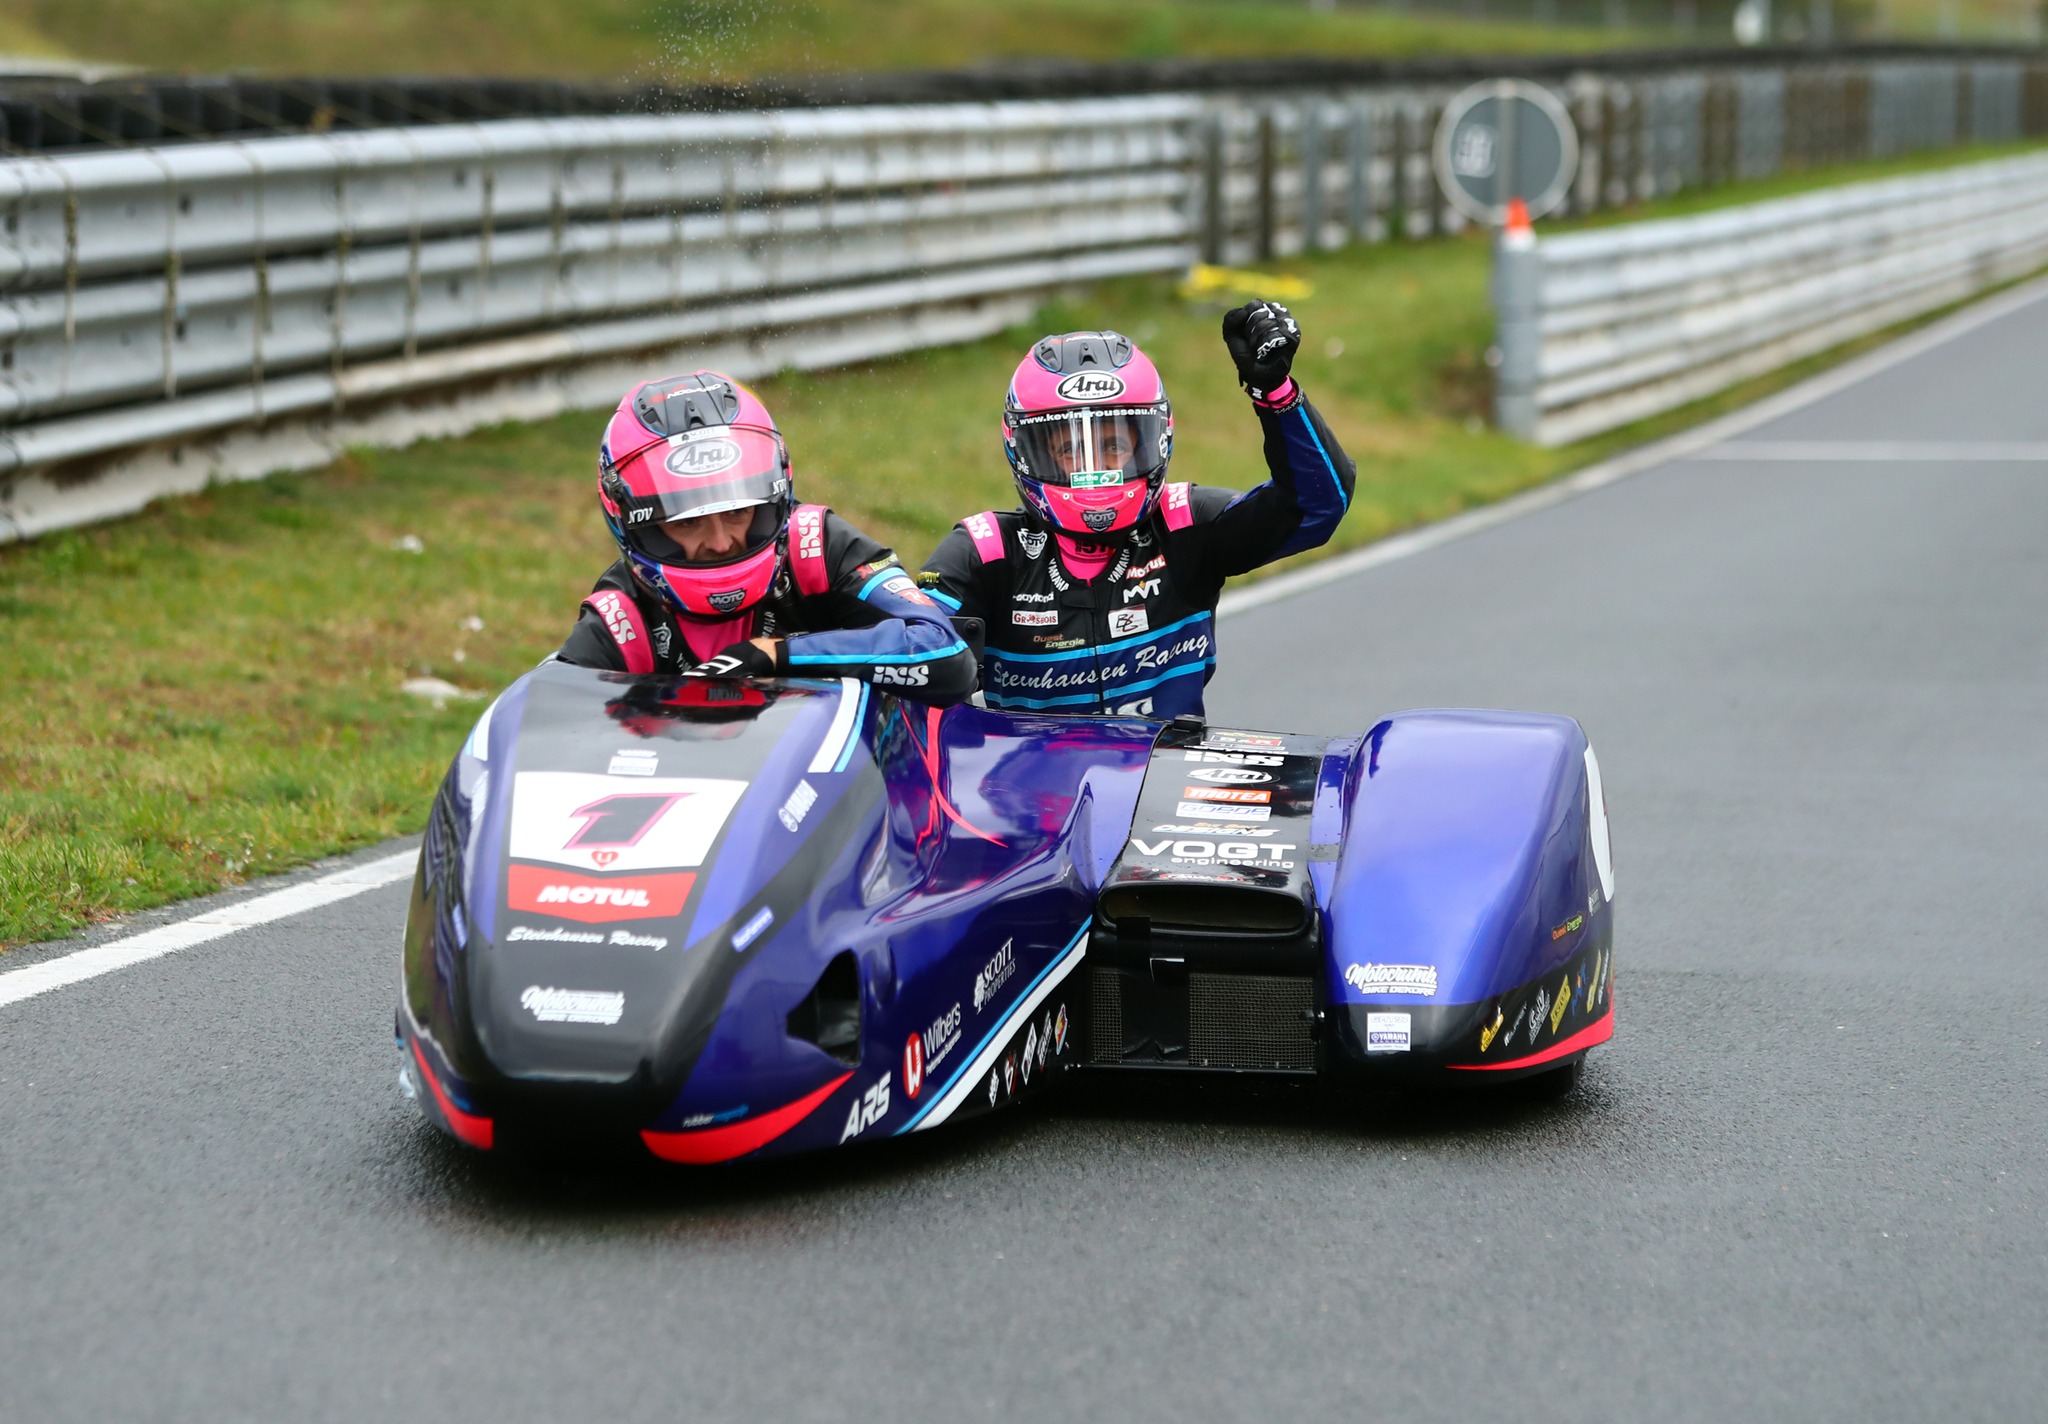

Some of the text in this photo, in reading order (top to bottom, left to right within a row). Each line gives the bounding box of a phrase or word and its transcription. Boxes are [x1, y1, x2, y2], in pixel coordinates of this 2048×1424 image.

[1063, 376, 1116, 396] Arai
[673, 442, 733, 469] Arai
[1083, 512, 1116, 523] MOTO
[1048, 558, 1070, 592] YAMAHA
[1108, 549, 1130, 584] YAMAHA
[1126, 556, 1166, 579] MOTUL
[709, 590, 745, 605] MOTO
[1123, 578, 1161, 603] MVT
[1045, 638, 1085, 650] Energie
[993, 634, 1210, 690] Steinhausen Racing
[562, 792, 698, 849] 1
[1131, 839, 1296, 861] VOGT
[1171, 857, 1294, 869] engineering
[537, 886, 650, 907] MOTUL
[507, 927, 667, 951] Steinhausen Racing
[984, 937, 1013, 988] SCOTT
[983, 959, 1016, 1004] PROPERTIES
[1362, 985, 1436, 996] BIKE DEKORE
[923, 1002, 961, 1058] Wilbers
[1379, 1032, 1407, 1041] YAMAHA
[840, 1071, 891, 1146] ARS
